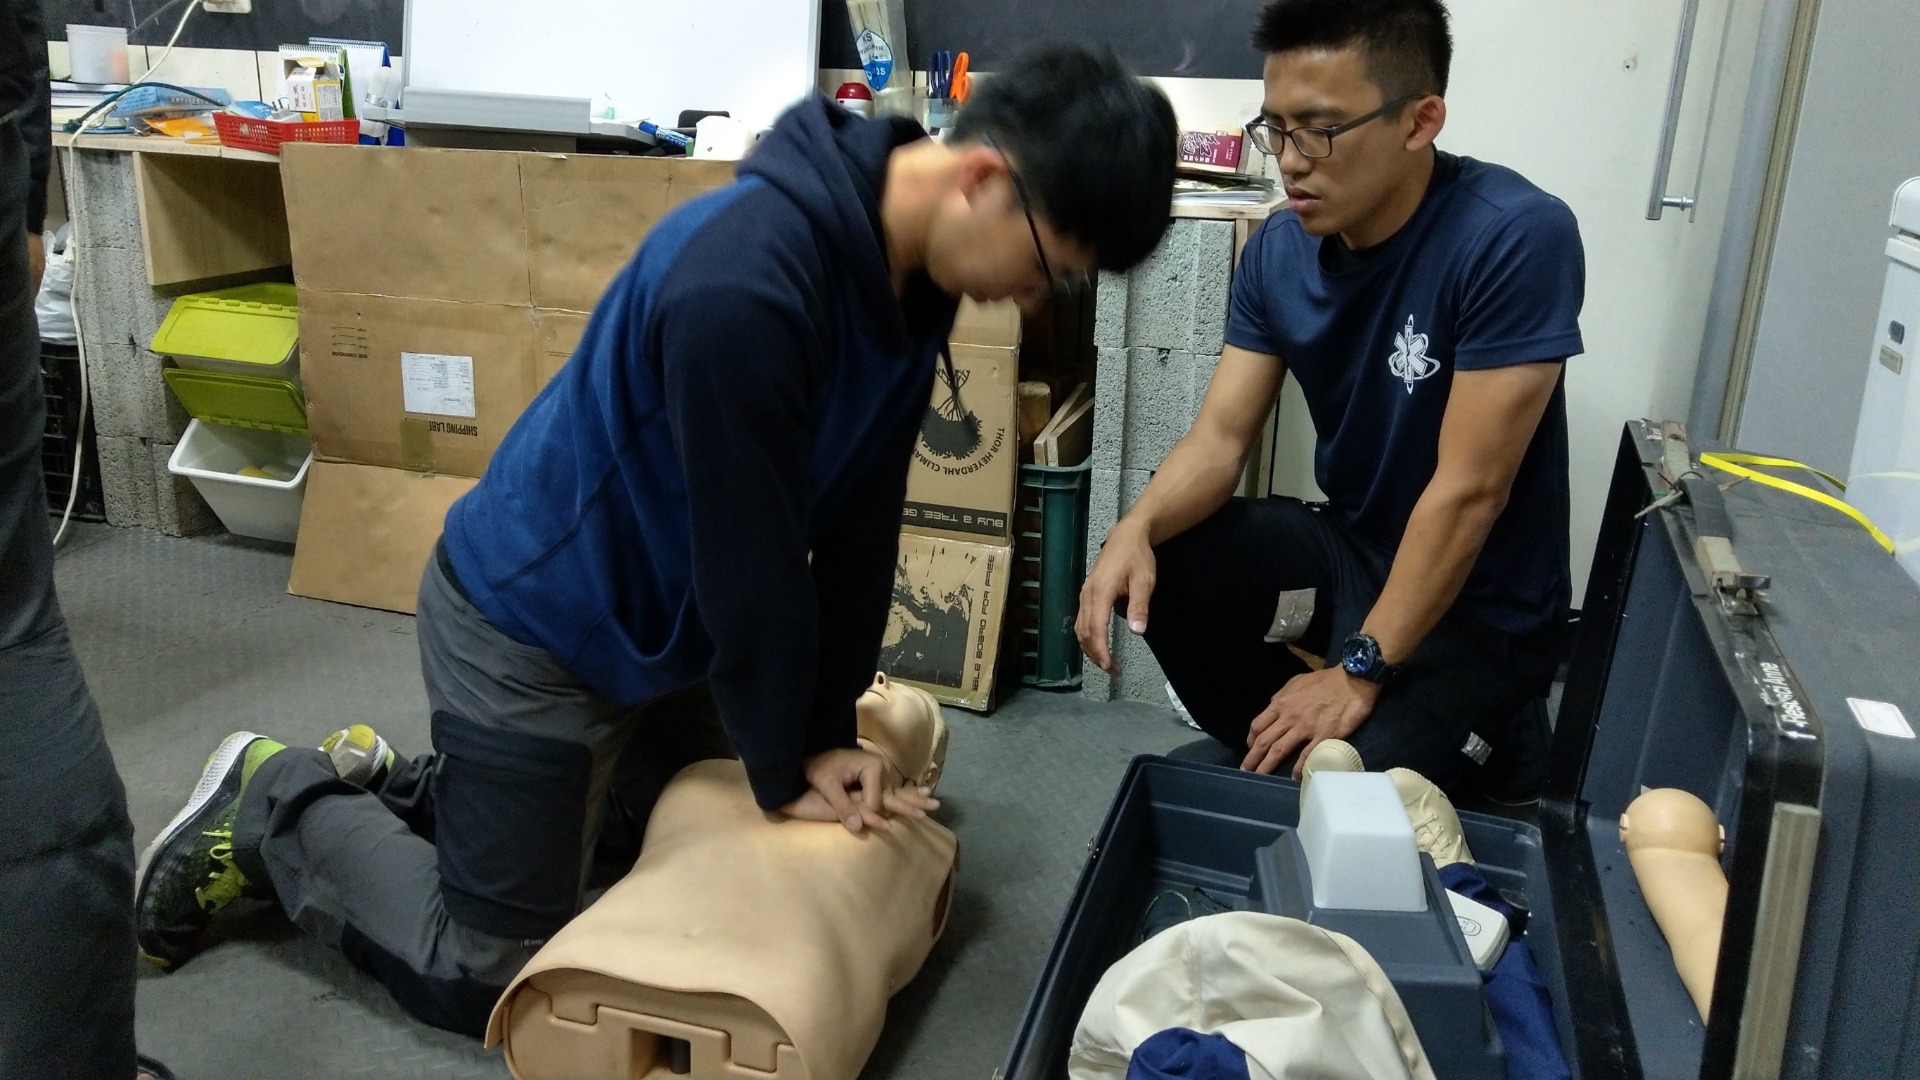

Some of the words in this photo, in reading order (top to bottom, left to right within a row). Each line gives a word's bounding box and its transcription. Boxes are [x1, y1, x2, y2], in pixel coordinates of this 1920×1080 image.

[447, 422, 478, 437] SHIPPING
[990, 427, 1005, 454] THOR
[943, 451, 994, 476] HEYERDAHL
[922, 508, 958, 522] TREE,
[977, 517, 1004, 528] BUY
[985, 554, 995, 587] FREE
[982, 591, 990, 615] FOR
[1760, 662, 1788, 687] Anne
